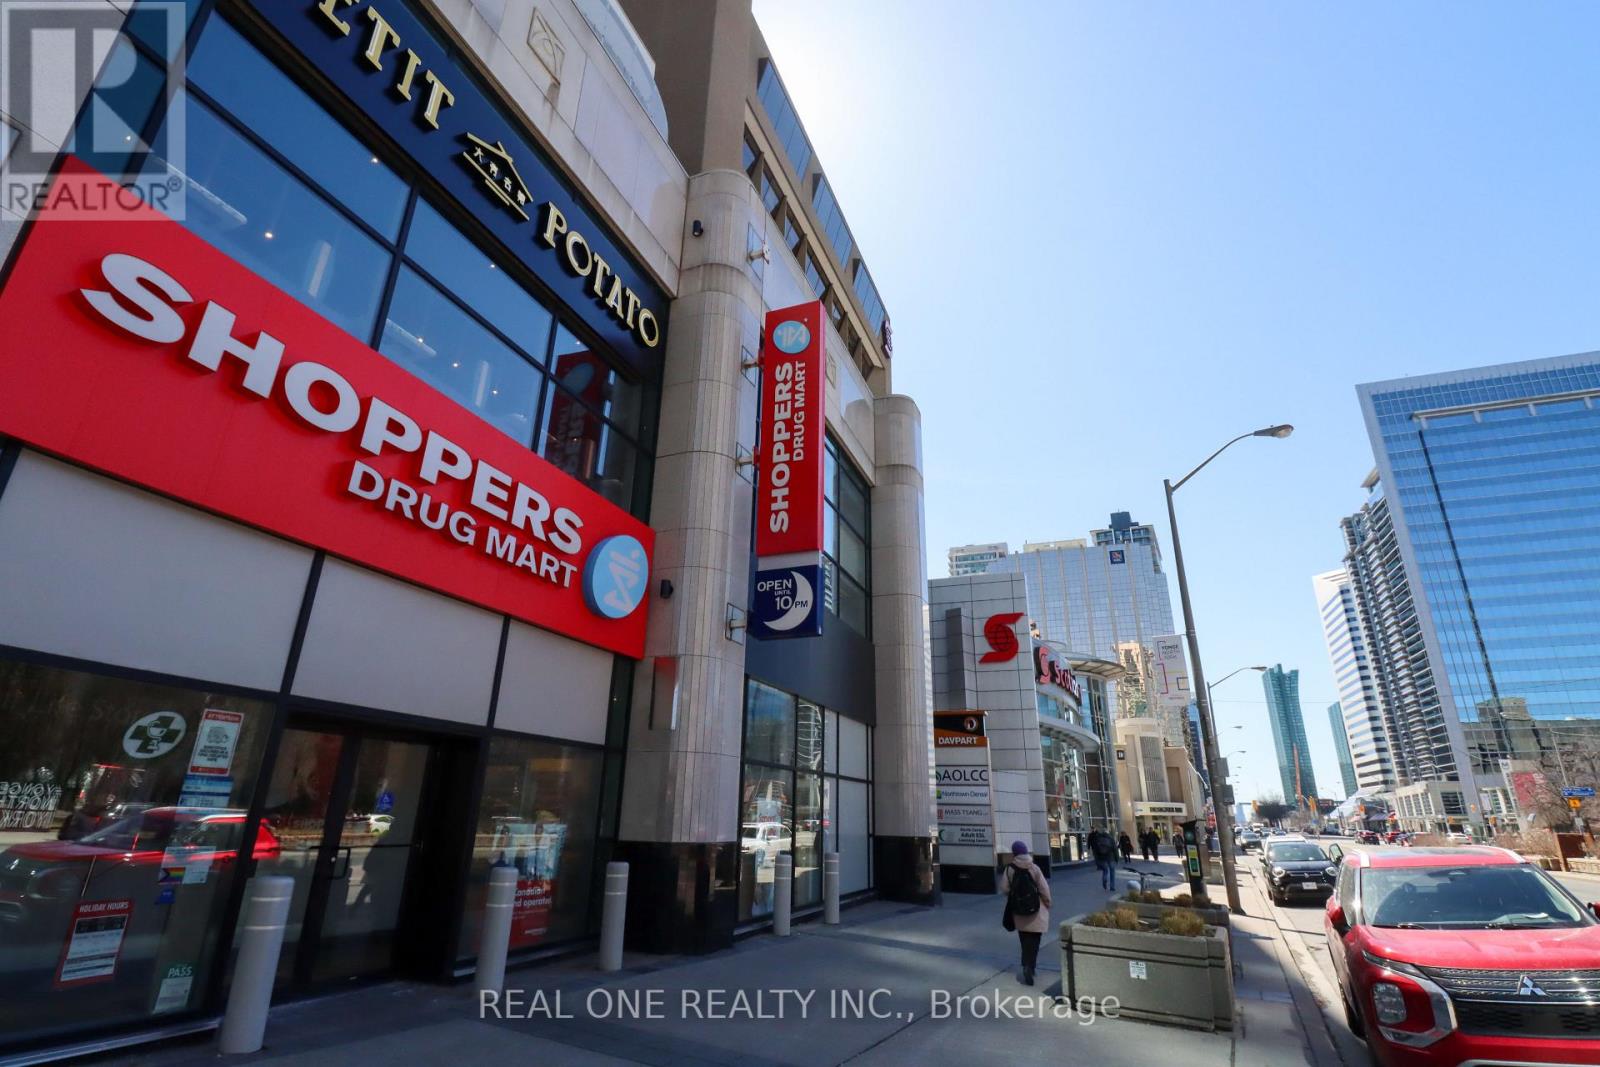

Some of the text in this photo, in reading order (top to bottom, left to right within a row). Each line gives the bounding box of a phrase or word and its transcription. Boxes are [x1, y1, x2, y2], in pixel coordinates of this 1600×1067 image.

[543, 201, 660, 348] POTATO
[79, 252, 585, 556] SHOPPERS
[793, 360, 806, 462] DRUG MART
[769, 361, 793, 534] SHOPPERS
[347, 459, 578, 588] DRUG MART
[757, 578, 793, 593] OPEN
[774, 588, 792, 597] UNTIL
[775, 595, 809, 611] 10 PM
[938, 736, 977, 745] DAVPART
[942, 769, 988, 782] AOLCC
[79, 901, 129, 913] HOLIDAY HOURS
[167, 966, 193, 978] PASS
